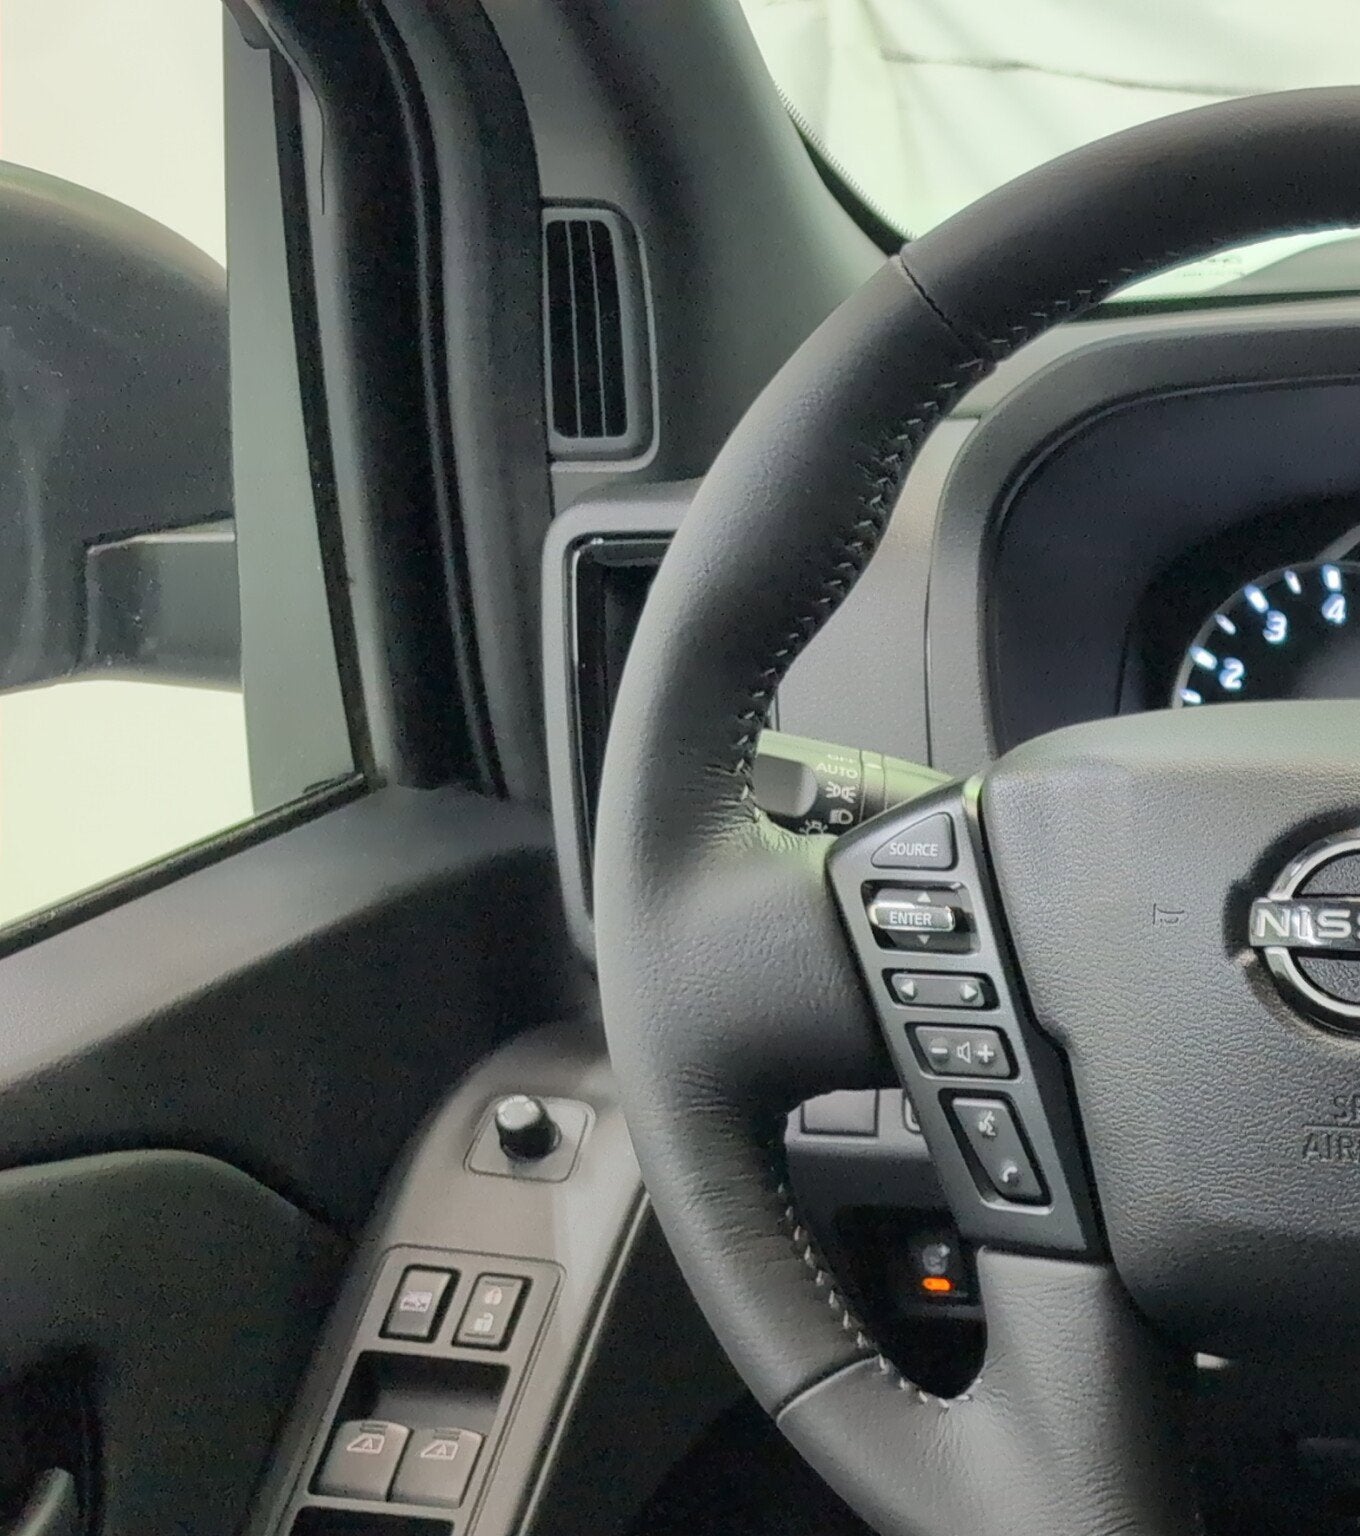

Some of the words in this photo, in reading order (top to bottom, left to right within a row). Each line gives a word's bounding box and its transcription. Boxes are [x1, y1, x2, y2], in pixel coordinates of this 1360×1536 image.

[1321, 592, 1347, 625] 4
[1262, 610, 1288, 644] 3
[1218, 657, 1245, 690] 2
[816, 762, 859, 779] AUTO
[889, 843, 939, 857] SOURCE
[889, 911, 933, 927] ENTER
